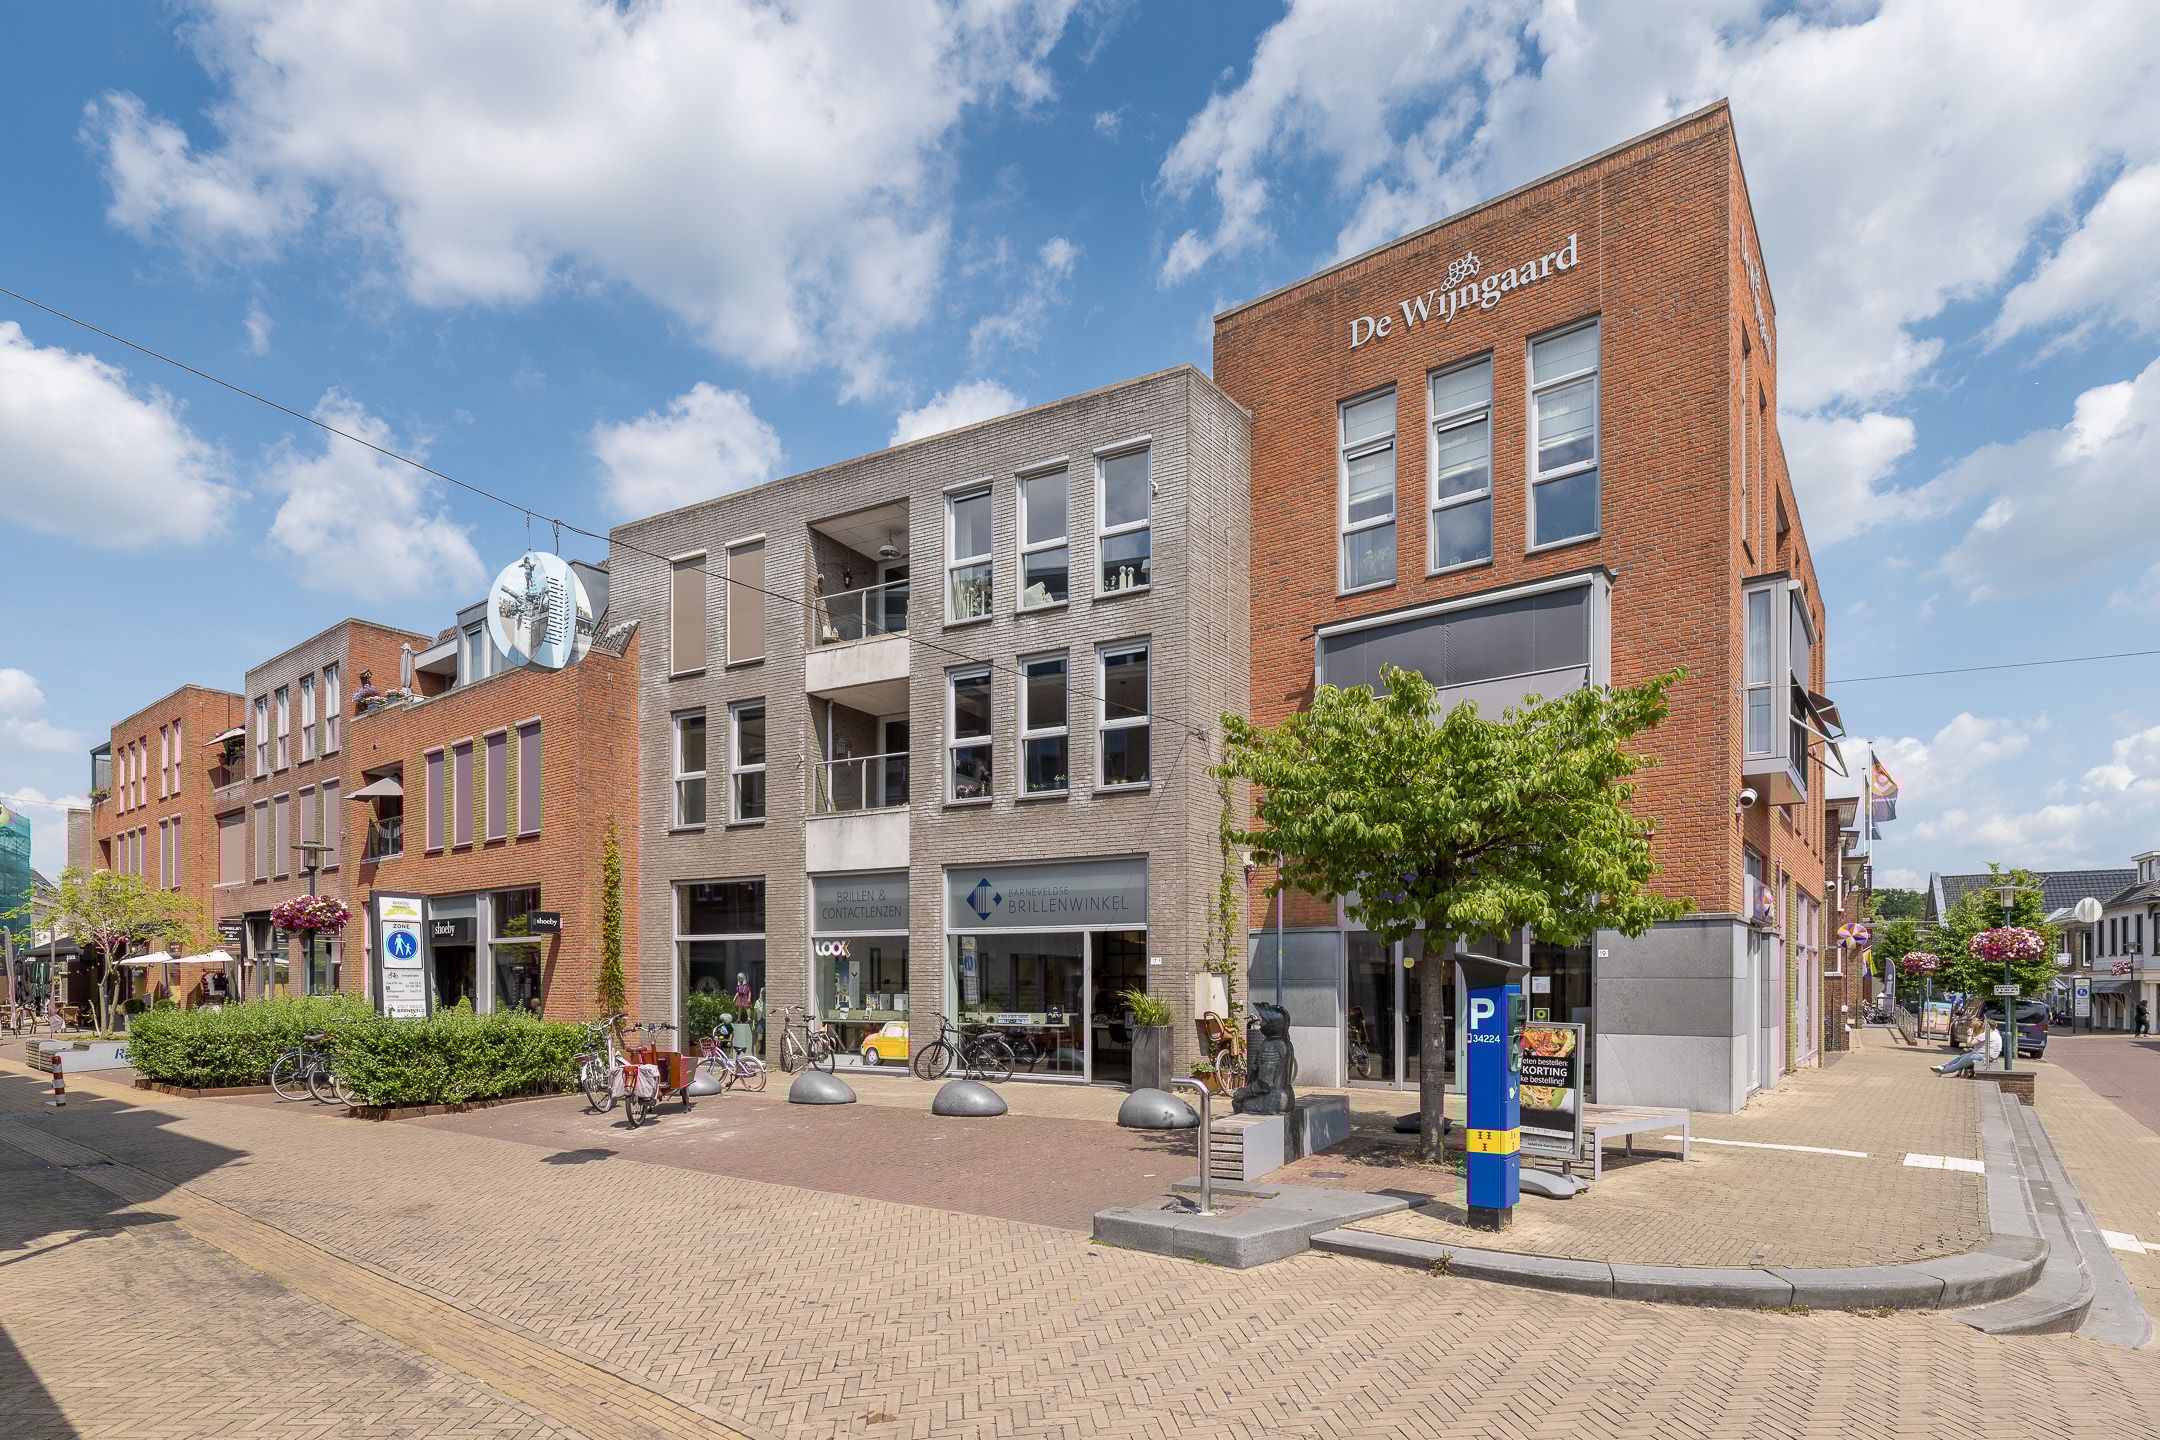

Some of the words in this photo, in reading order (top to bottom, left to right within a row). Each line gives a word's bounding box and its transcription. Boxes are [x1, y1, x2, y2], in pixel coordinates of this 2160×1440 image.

[1349, 315, 1392, 349] De
[1399, 233, 1580, 328] Wijngaard
[836, 890, 874, 903] BRILLEN
[878, 890, 887, 901] &
[1008, 886, 1069, 898] BARNEVELDSE
[1008, 896, 1129, 914] BRILLENWINKEL
[822, 905, 902, 920] CONTACTLENZEN
[434, 921, 456, 936] shoeby
[536, 918, 558, 926] shoeby
[815, 940, 851, 958] LOOK
[1470, 997, 1495, 1030] P
[1473, 1034, 1501, 1044] 34224
[1522, 1057, 1537, 1065] eten
[1522, 1065, 1568, 1077] KORTING
[1529, 1076, 1565, 1087] bestelling!
